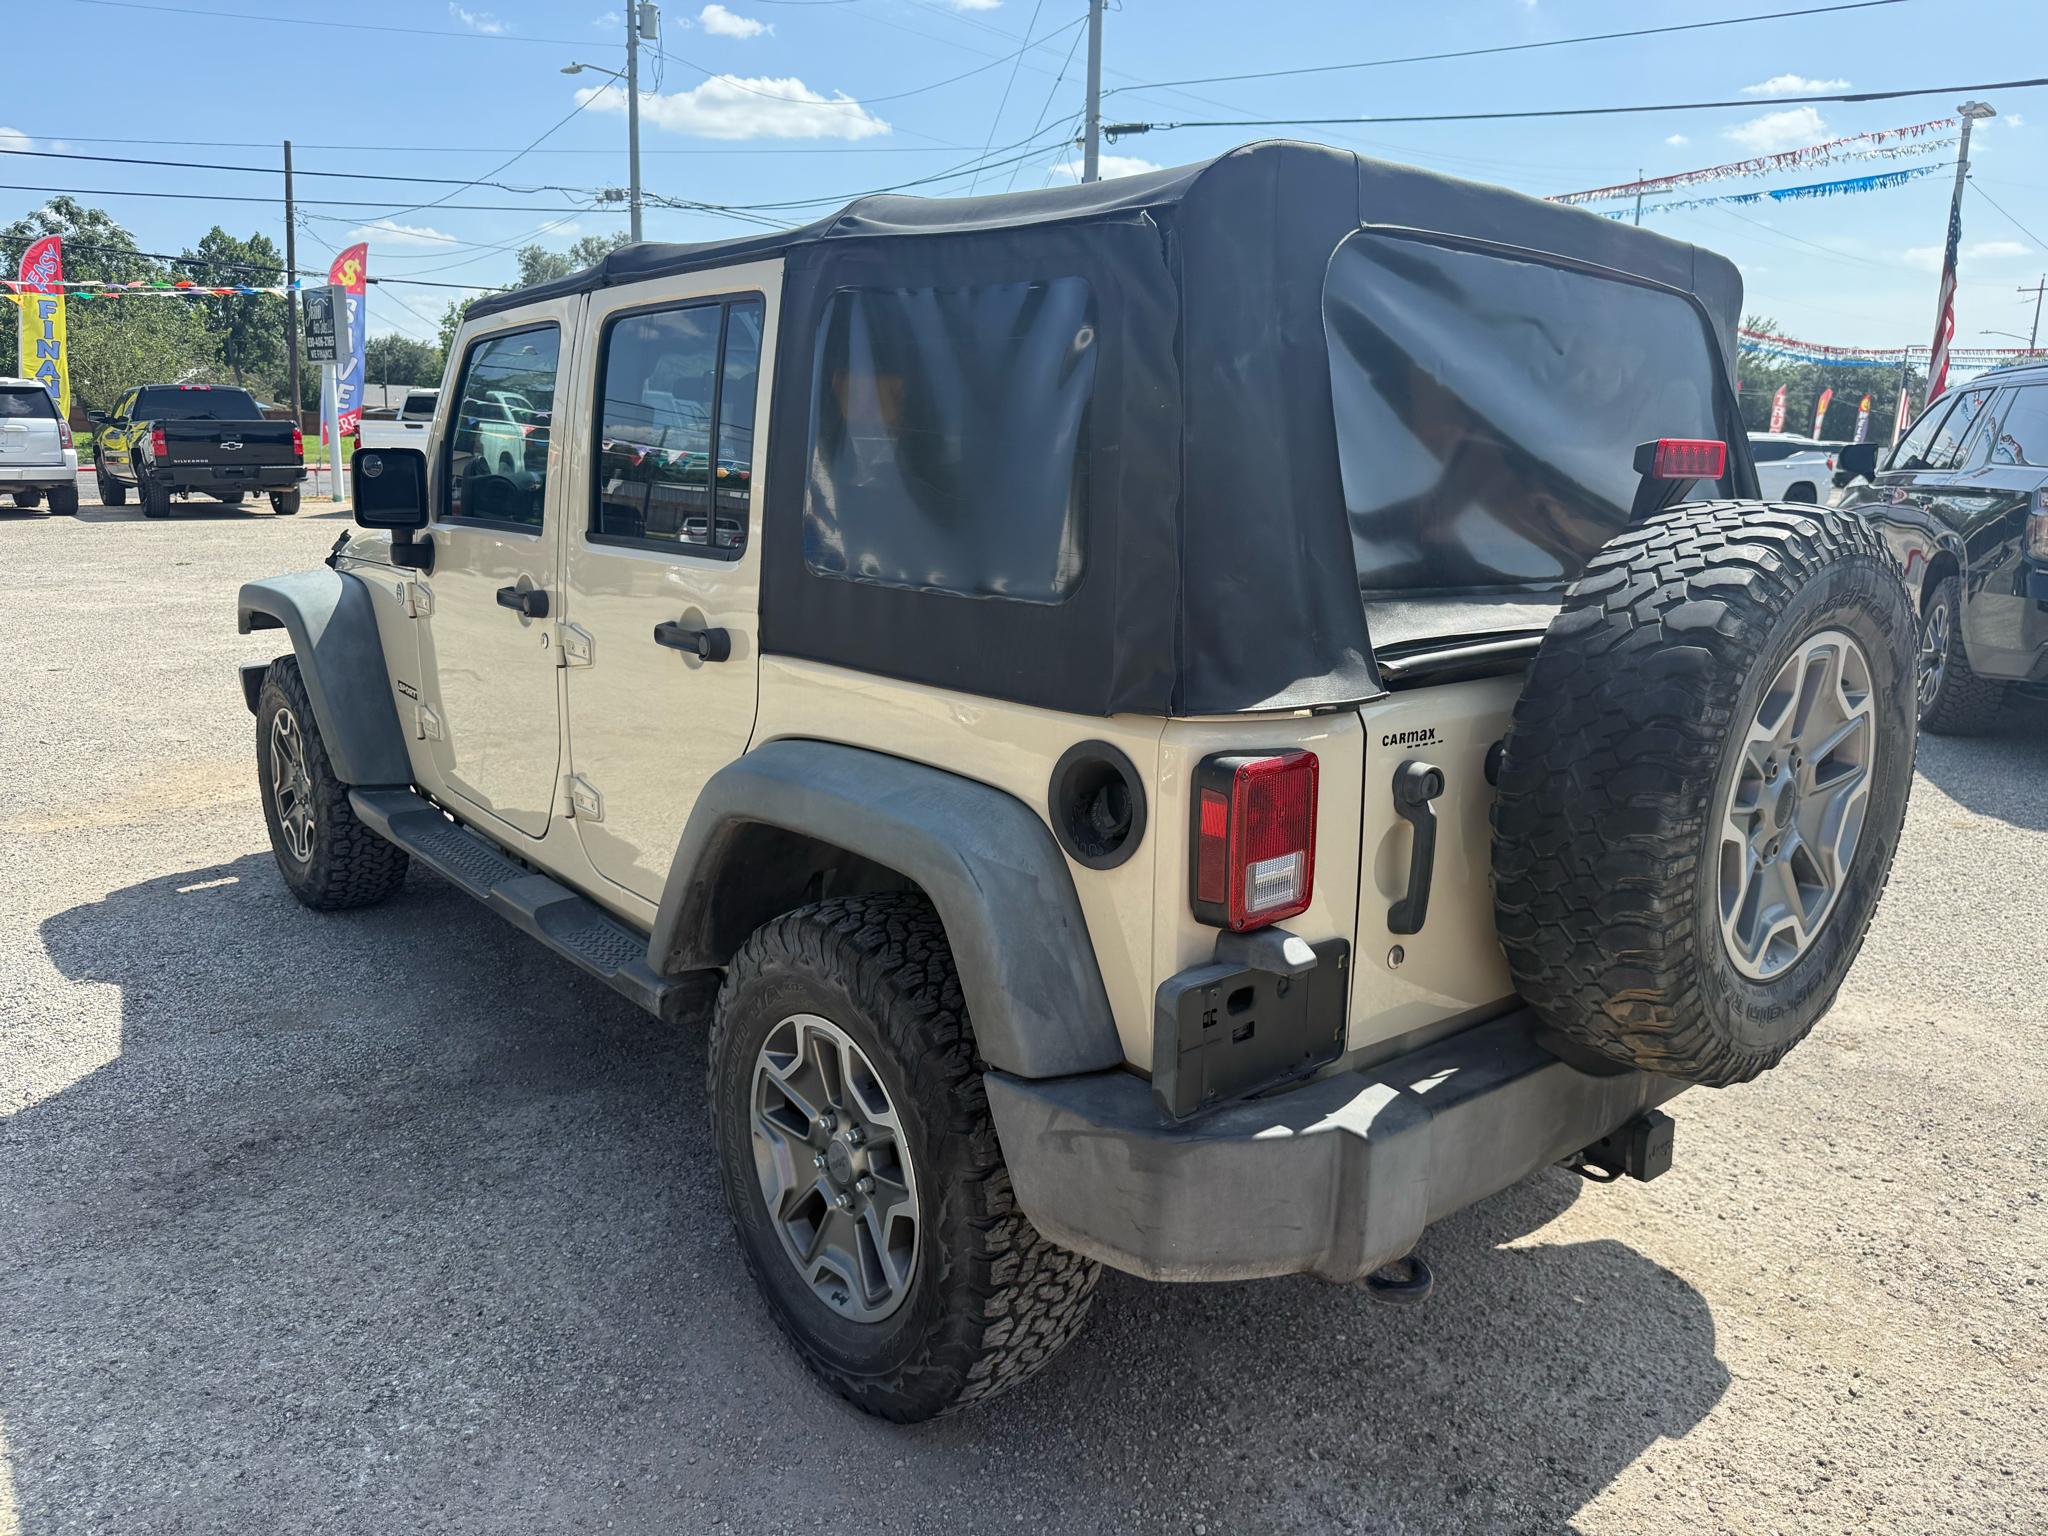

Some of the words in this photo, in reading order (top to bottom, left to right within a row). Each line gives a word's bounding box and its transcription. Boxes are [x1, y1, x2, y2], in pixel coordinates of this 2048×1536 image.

[26, 243, 60, 291] EASY
[35, 299, 62, 405] FINAN
[398, 681, 418, 699] SPORT
